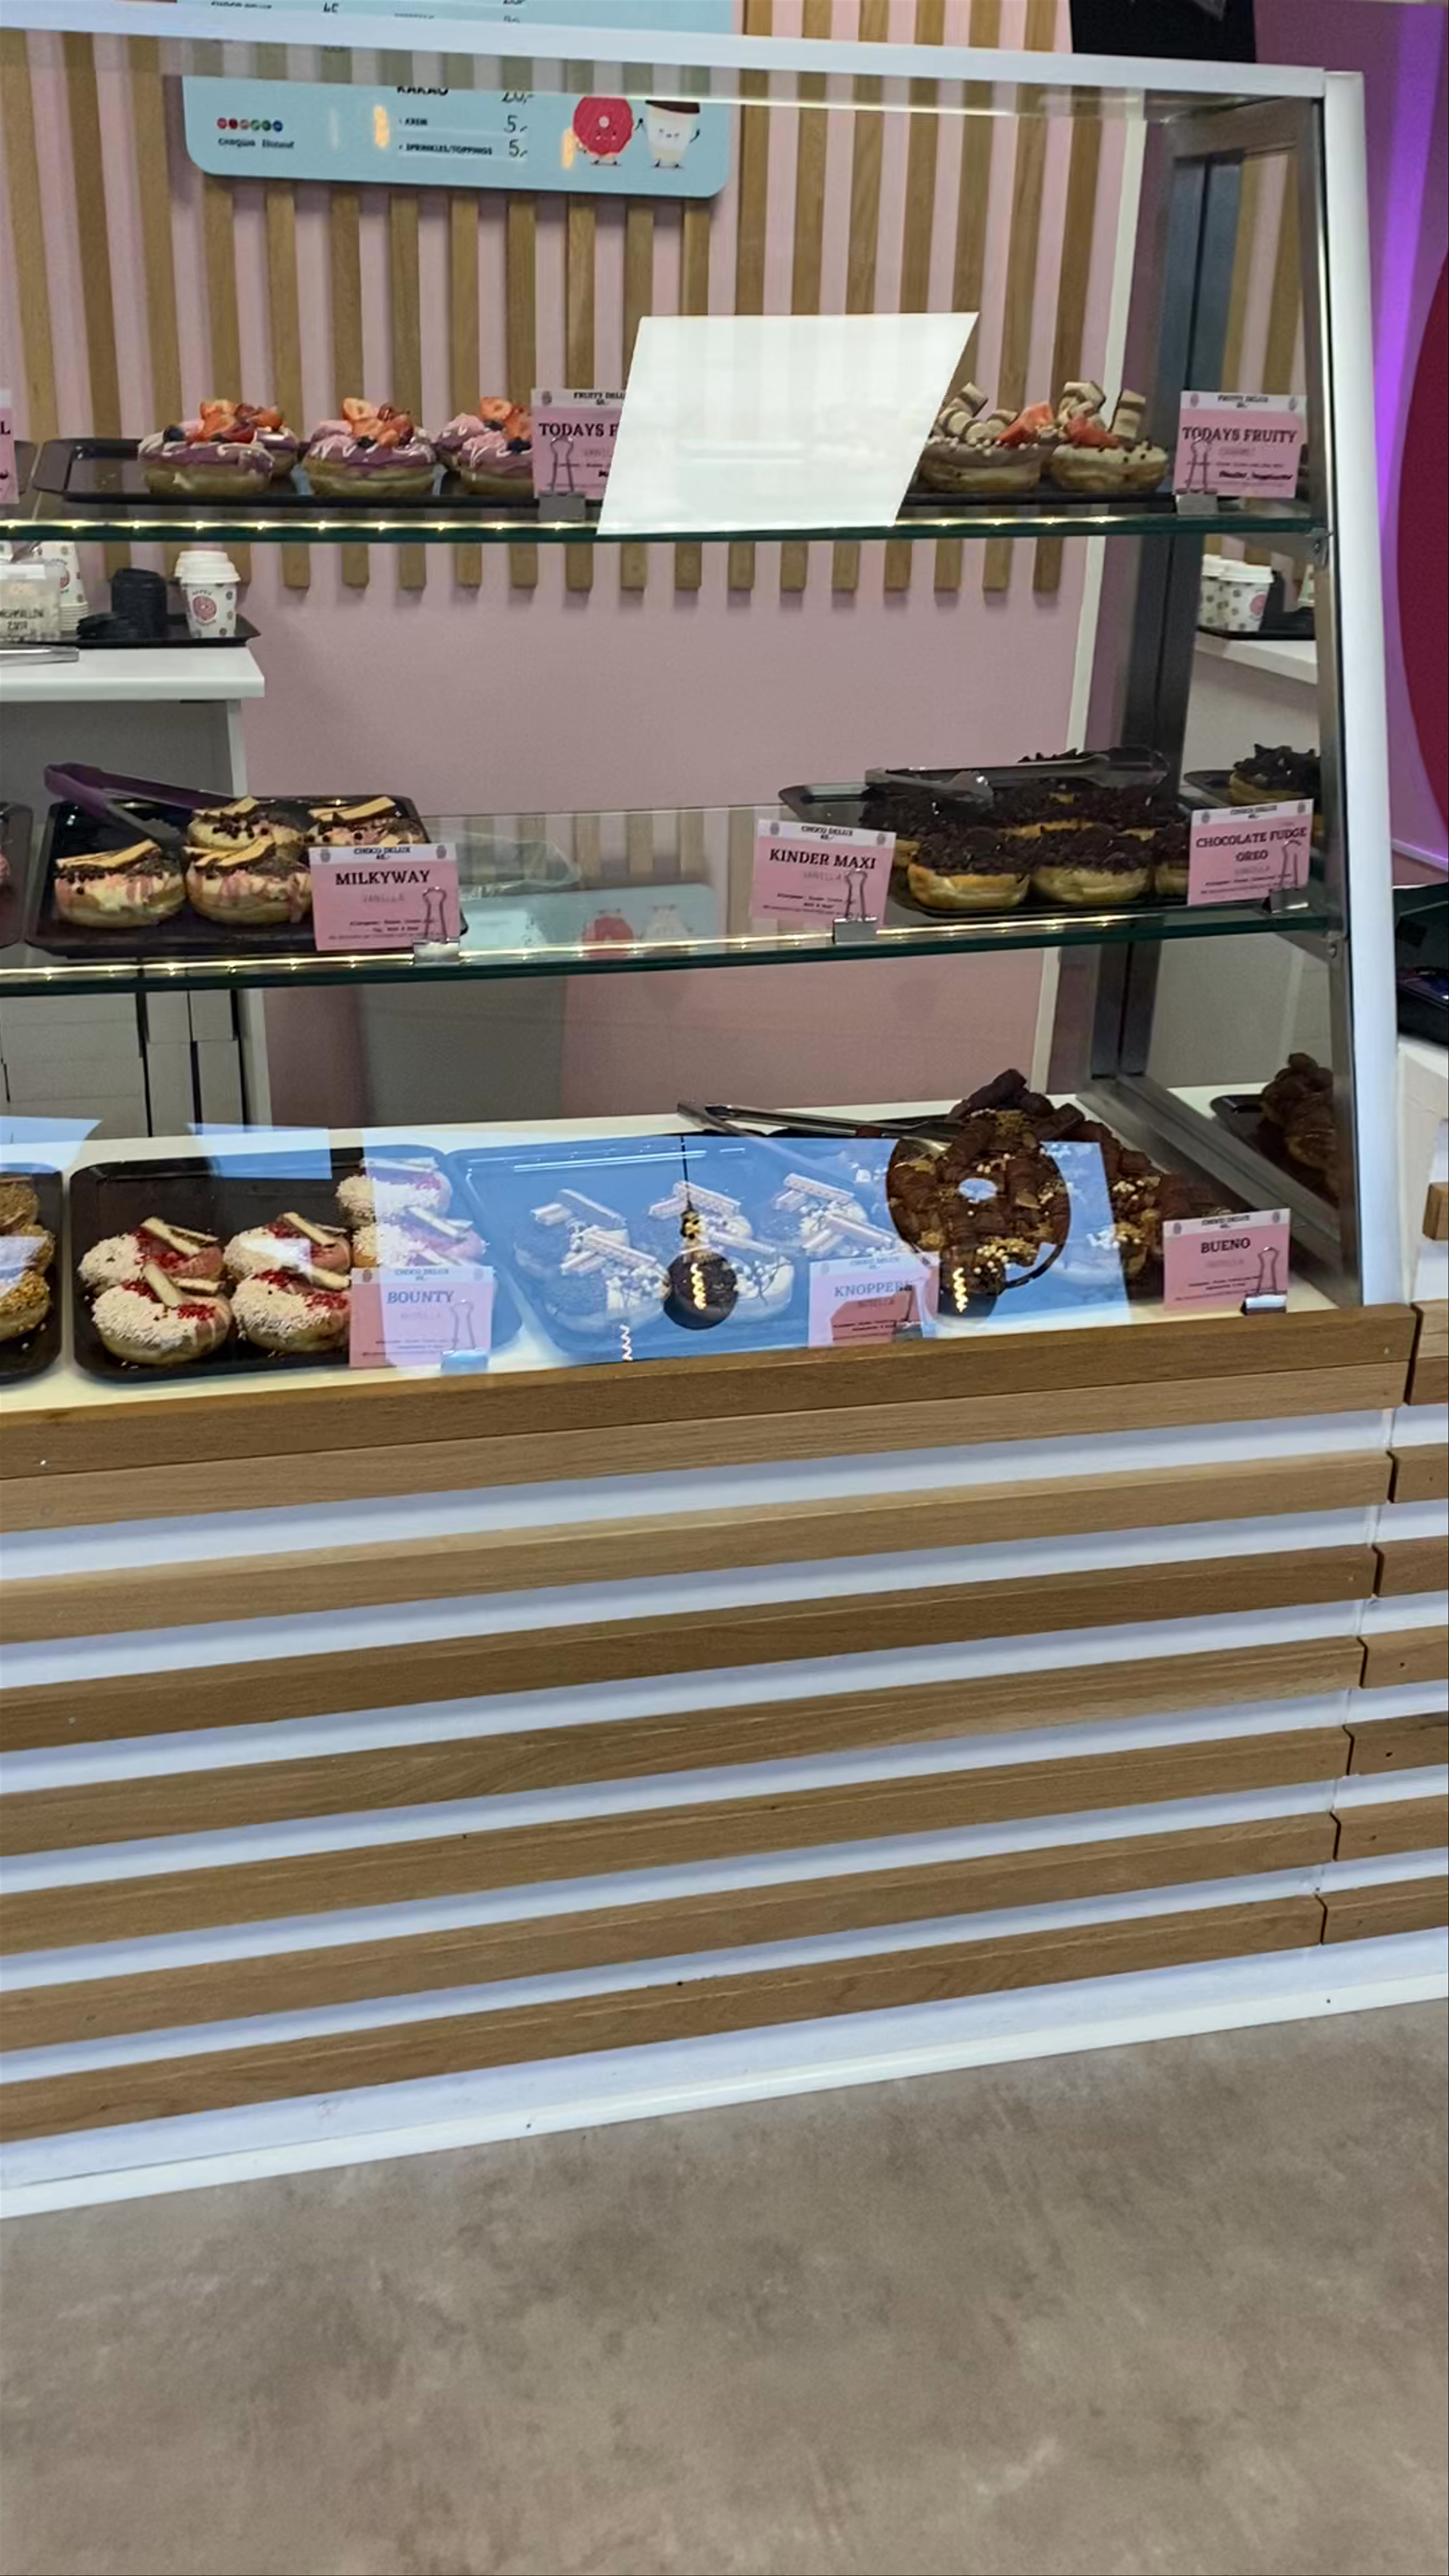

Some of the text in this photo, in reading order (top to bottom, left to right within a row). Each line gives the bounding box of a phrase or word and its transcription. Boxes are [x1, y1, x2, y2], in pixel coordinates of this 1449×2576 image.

[538, 423, 605, 436] TODAYS
[1182, 426, 1297, 444] TODAYS FRUITY
[1196, 827, 1307, 847] CHOCOLATE FUDGE
[769, 848, 877, 869] KINDER MAXI
[1236, 850, 1268, 862] OREO
[335, 869, 430, 885] MILKYWAY
[1201, 1238, 1251, 1254] BUENO
[387, 1290, 454, 1304] BOUNTY
